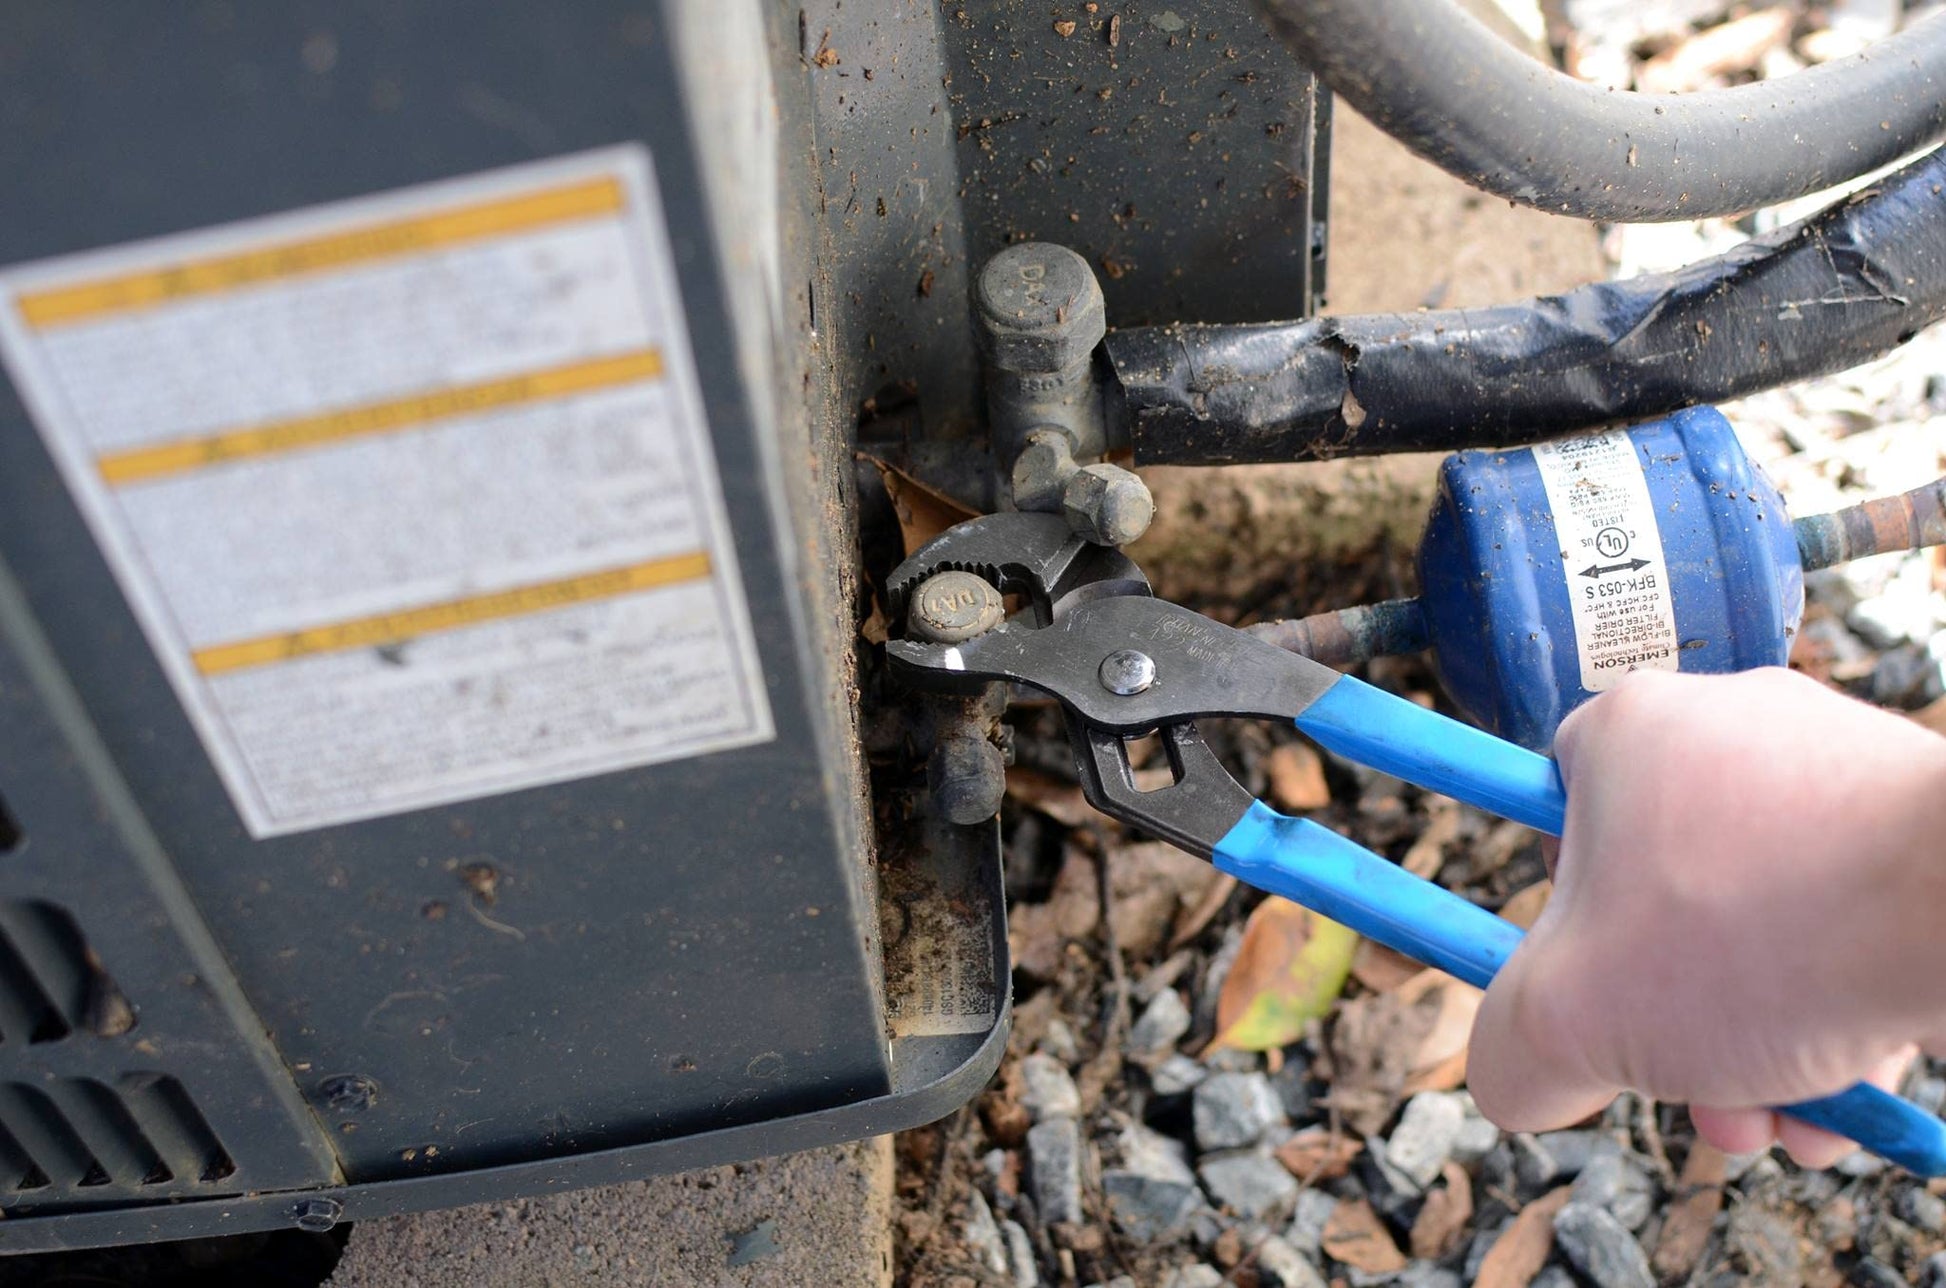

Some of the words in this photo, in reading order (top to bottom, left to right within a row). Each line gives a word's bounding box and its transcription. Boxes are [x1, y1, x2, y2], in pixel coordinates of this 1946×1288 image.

[1592, 513, 1624, 528] LISTED
[1598, 574, 1656, 597] BFK-053
[1585, 586, 1595, 599] S
[1616, 596, 1639, 607] HCFC
[1639, 603, 1654, 612] For
[1597, 610, 1617, 620] with
[1620, 606, 1636, 614] use
[1595, 619, 1624, 631] DRIER
[1626, 613, 1658, 626] FILTER
[1592, 621, 1665, 639] BI-DIRECTIONAL
[1633, 630, 1671, 642] BI-FLOW
[1591, 648, 1639, 660] Technologies
[1594, 649, 1669, 670] EMERSON
